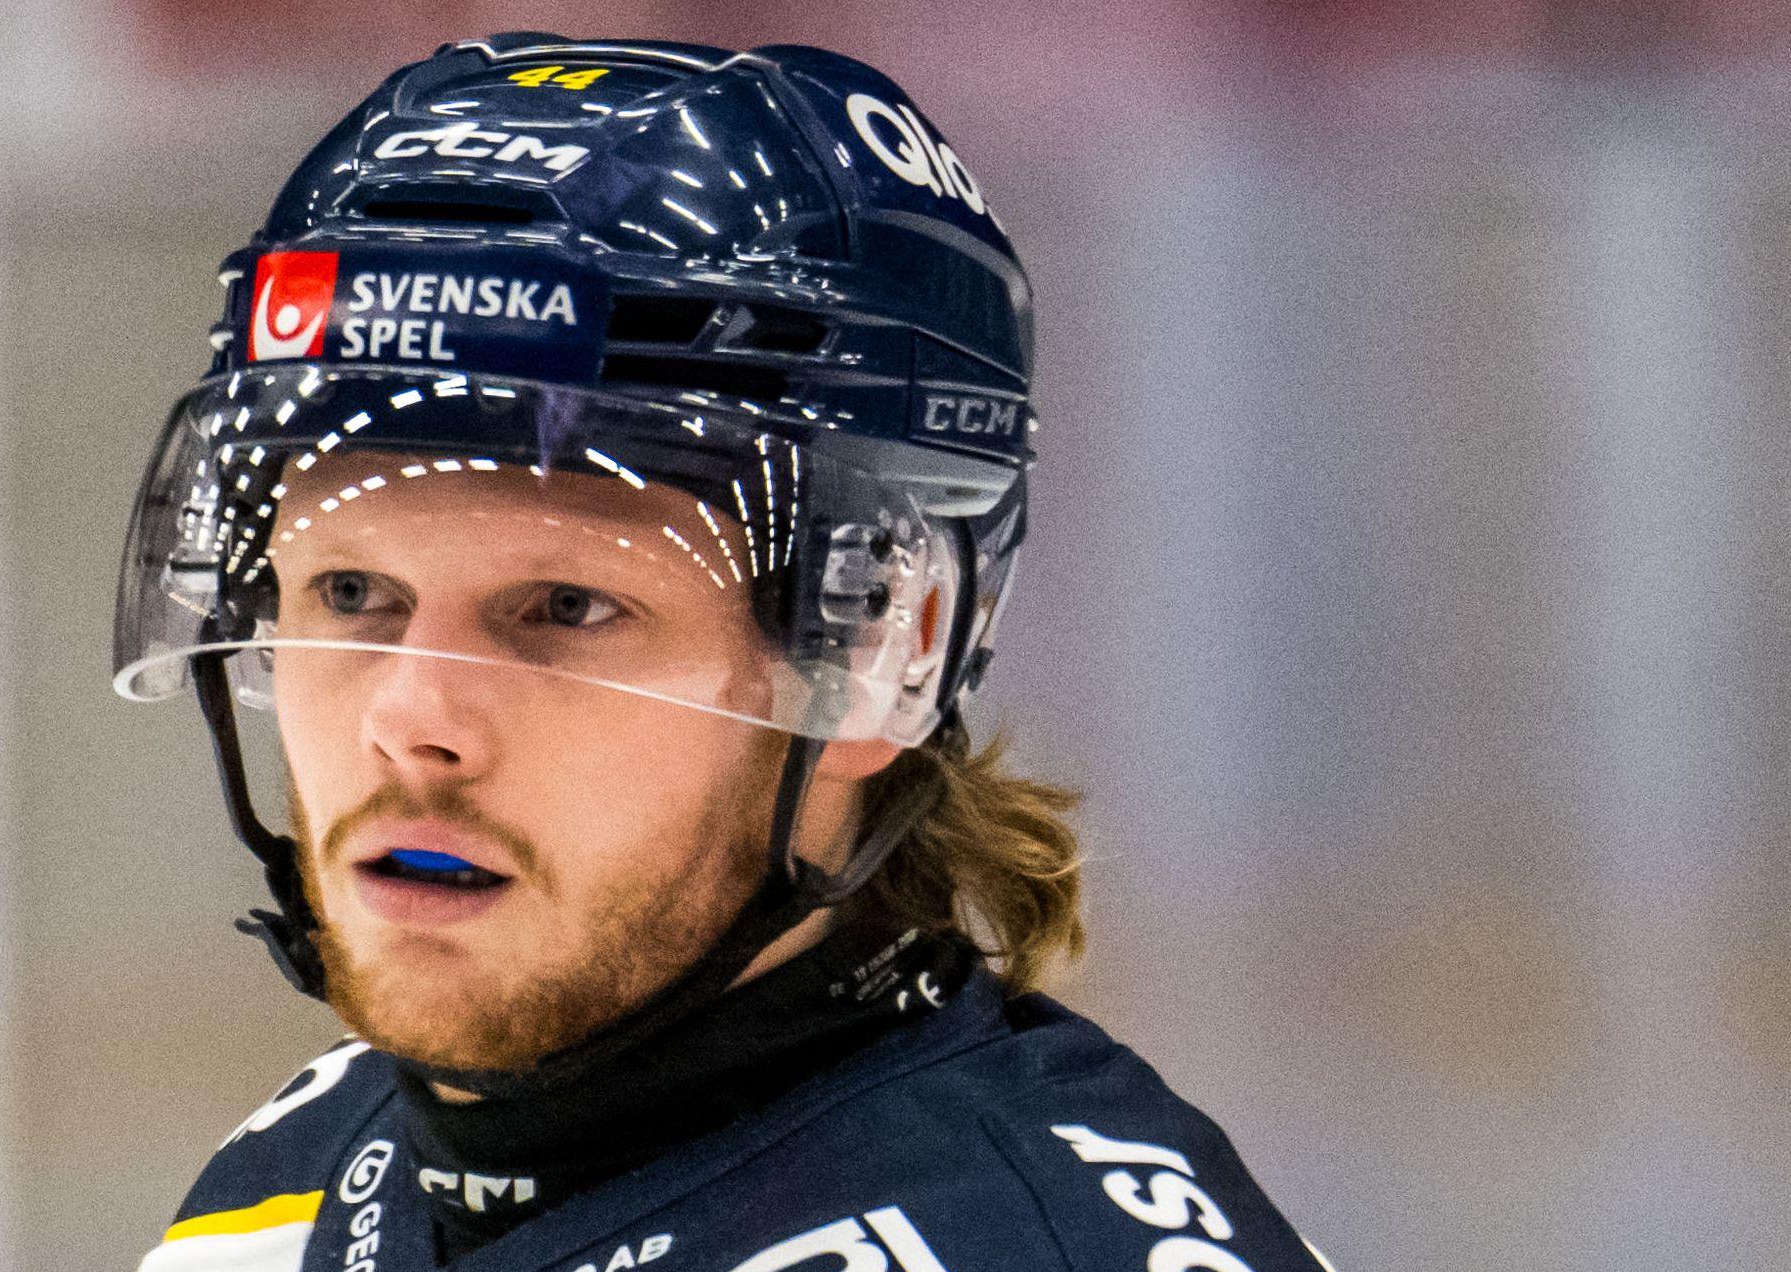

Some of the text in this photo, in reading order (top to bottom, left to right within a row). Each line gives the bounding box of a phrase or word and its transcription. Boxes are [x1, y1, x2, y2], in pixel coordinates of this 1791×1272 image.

[507, 66, 611, 90] 44
[374, 122, 591, 172] CCM
[348, 272, 578, 327] SVENSKA
[340, 322, 456, 361] SPEL
[923, 396, 1017, 435] CCM
